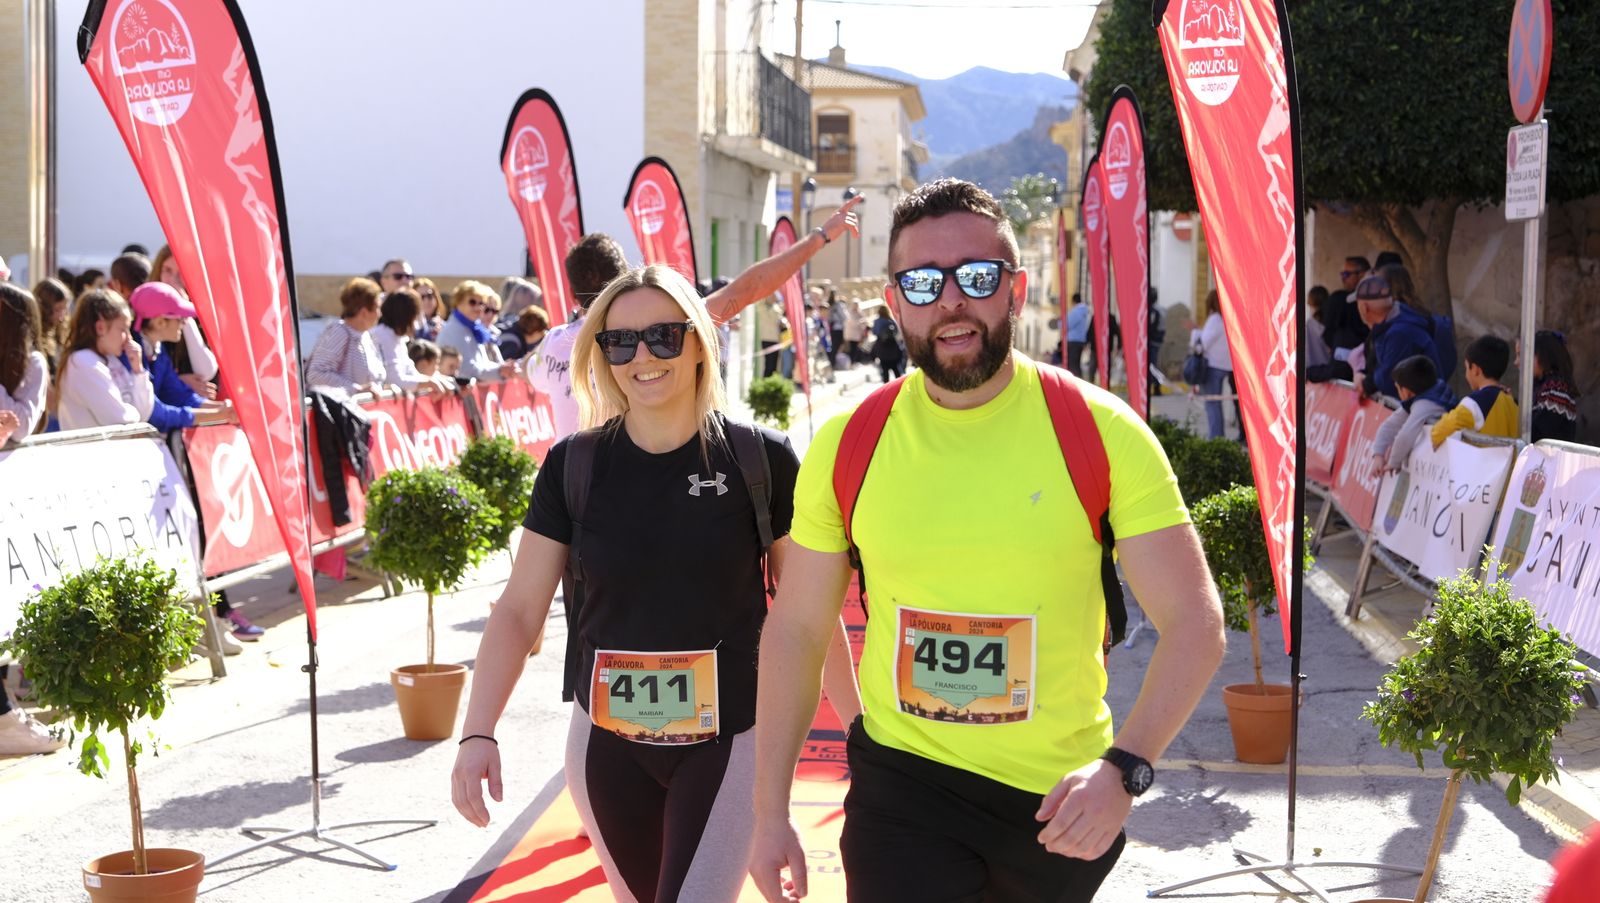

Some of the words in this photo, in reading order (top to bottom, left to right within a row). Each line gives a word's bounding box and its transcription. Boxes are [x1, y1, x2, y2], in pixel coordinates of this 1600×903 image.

[546, 355, 571, 382] Pep
[1526, 531, 1600, 598] CAN
[909, 619, 918, 628] LA
[918, 620, 952, 633] PÓLVORA
[968, 620, 1004, 629] CANTORIA
[604, 660, 613, 668] LA
[613, 660, 645, 669] PÓLVORA
[914, 637, 1005, 676] 494
[610, 674, 688, 703] 411
[935, 681, 978, 691] FRANCISCO
